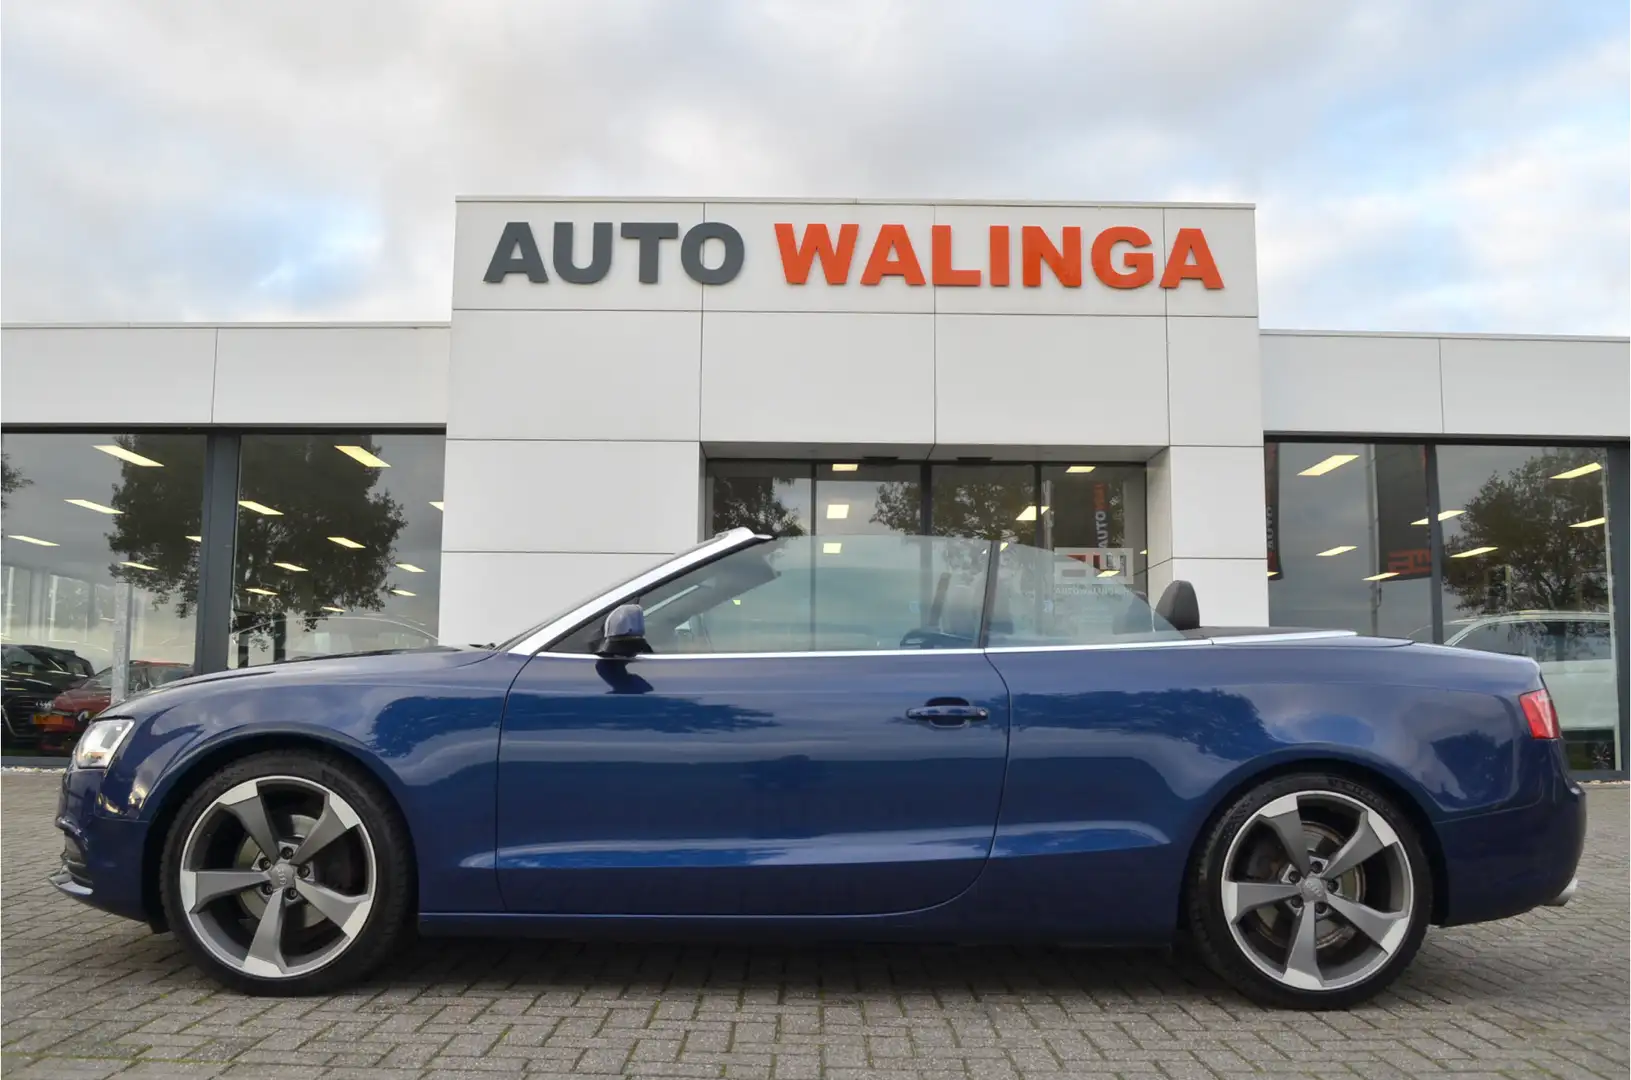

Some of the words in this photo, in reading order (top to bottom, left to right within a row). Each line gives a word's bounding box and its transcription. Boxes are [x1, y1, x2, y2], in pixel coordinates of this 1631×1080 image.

[483, 221, 745, 285] AUTO
[774, 223, 1225, 289] WALINGA
[1095, 511, 1108, 548] AUTO
